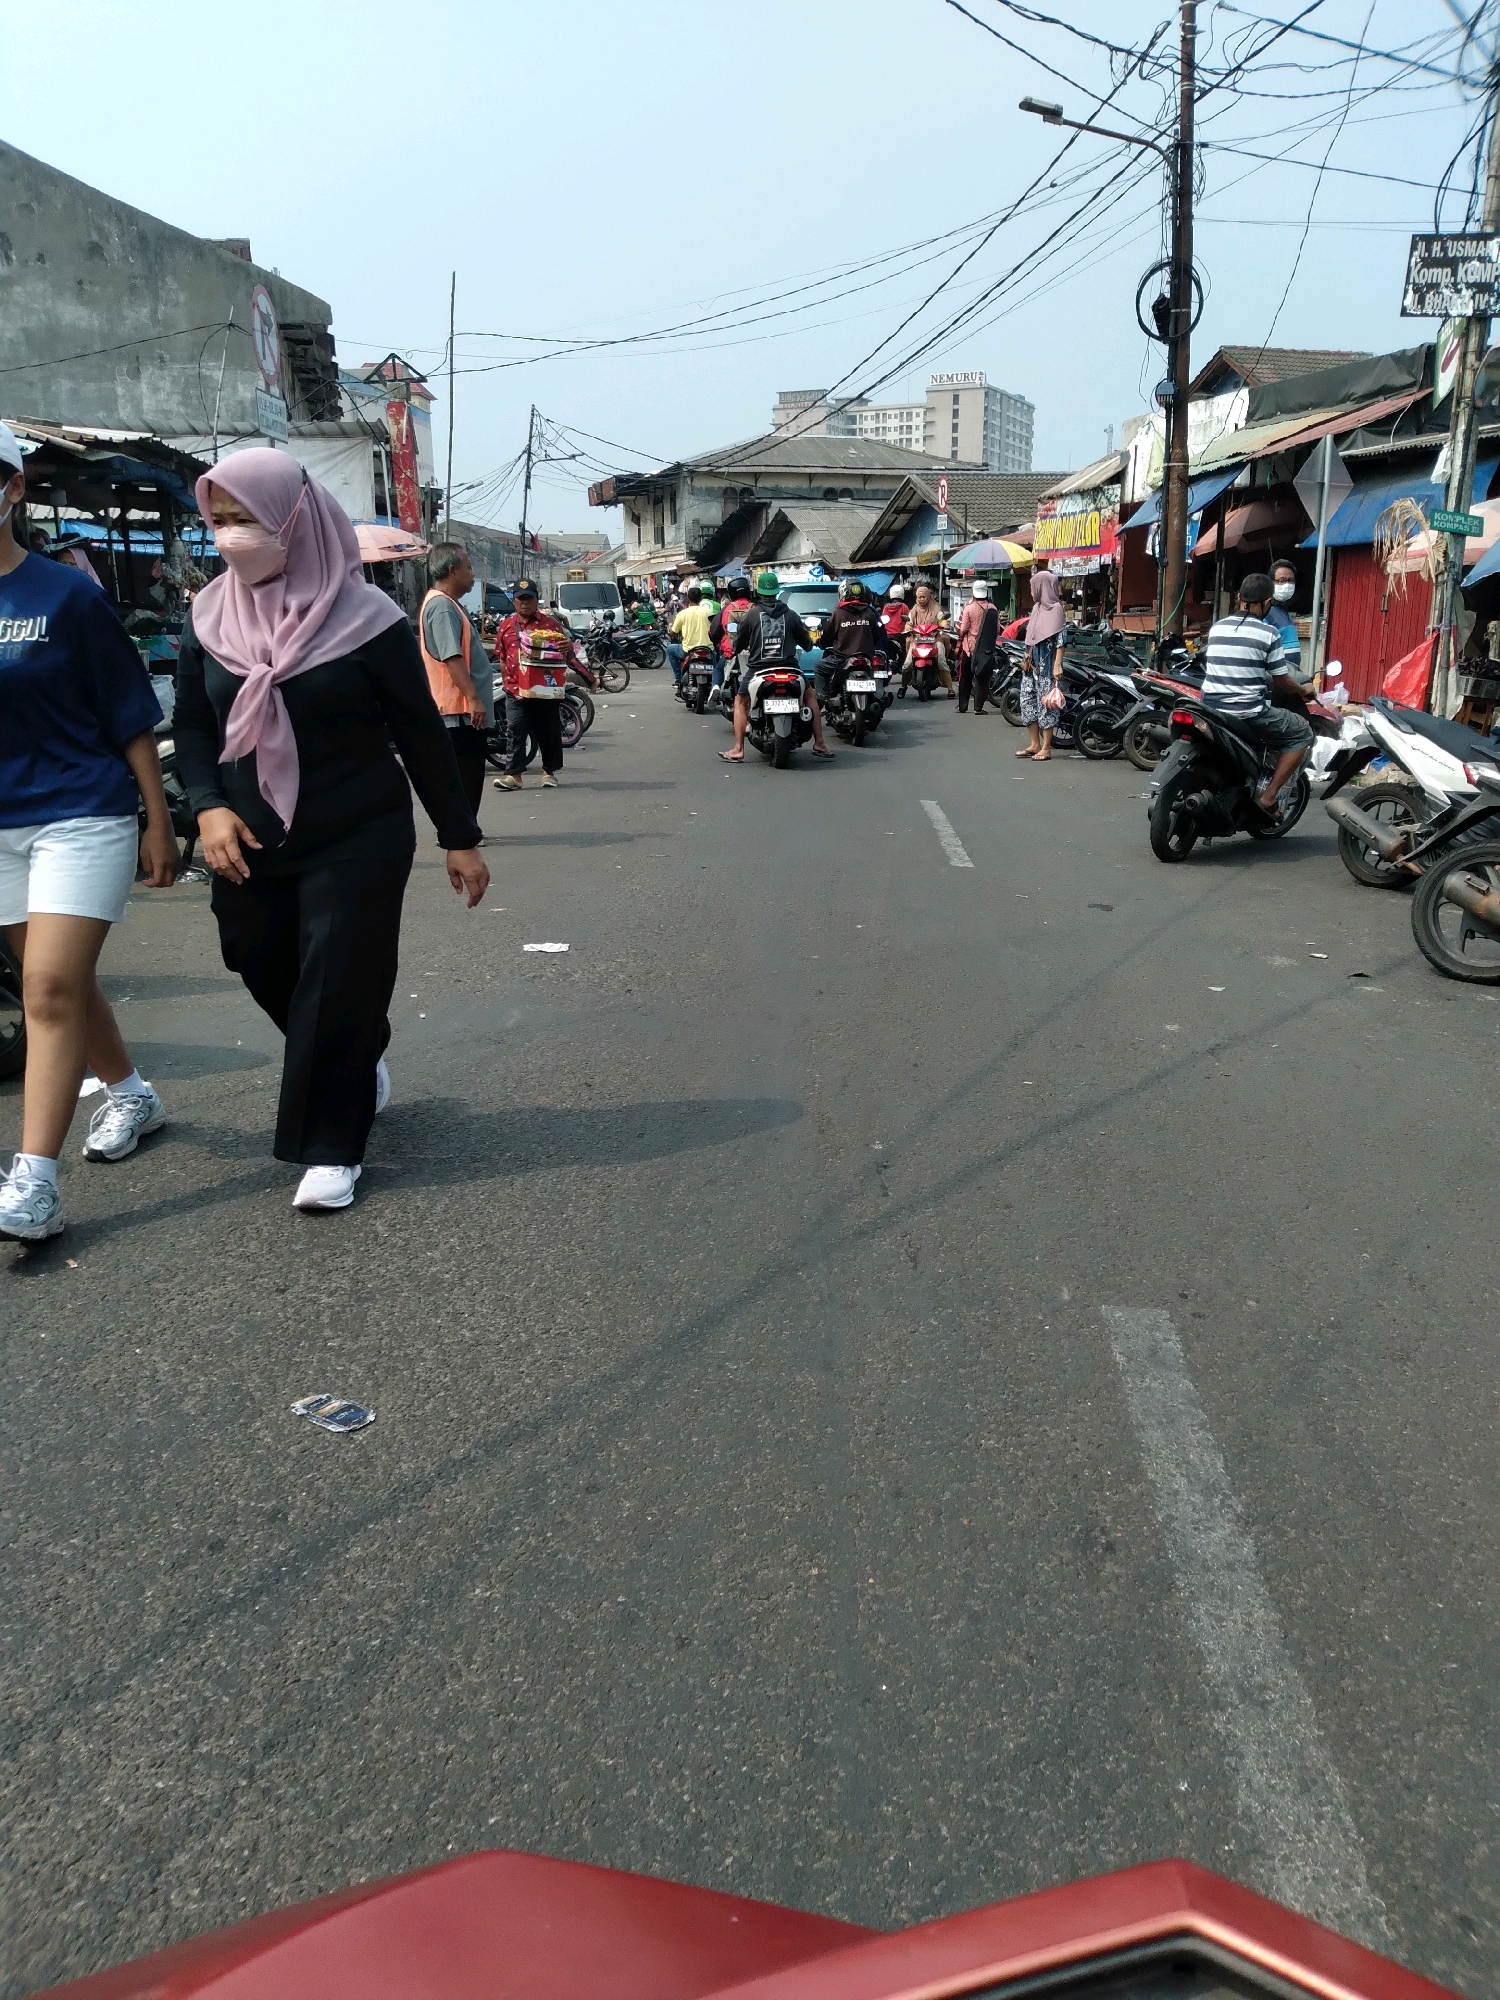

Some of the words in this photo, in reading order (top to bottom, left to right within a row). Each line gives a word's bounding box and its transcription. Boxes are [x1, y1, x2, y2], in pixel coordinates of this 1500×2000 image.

[1410, 262, 1455, 288] Komp.
[931, 371, 978, 384] NEMURU
[1434, 512, 1480, 526] KOMPLEK
[1433, 520, 1470, 532] KOMPAS
